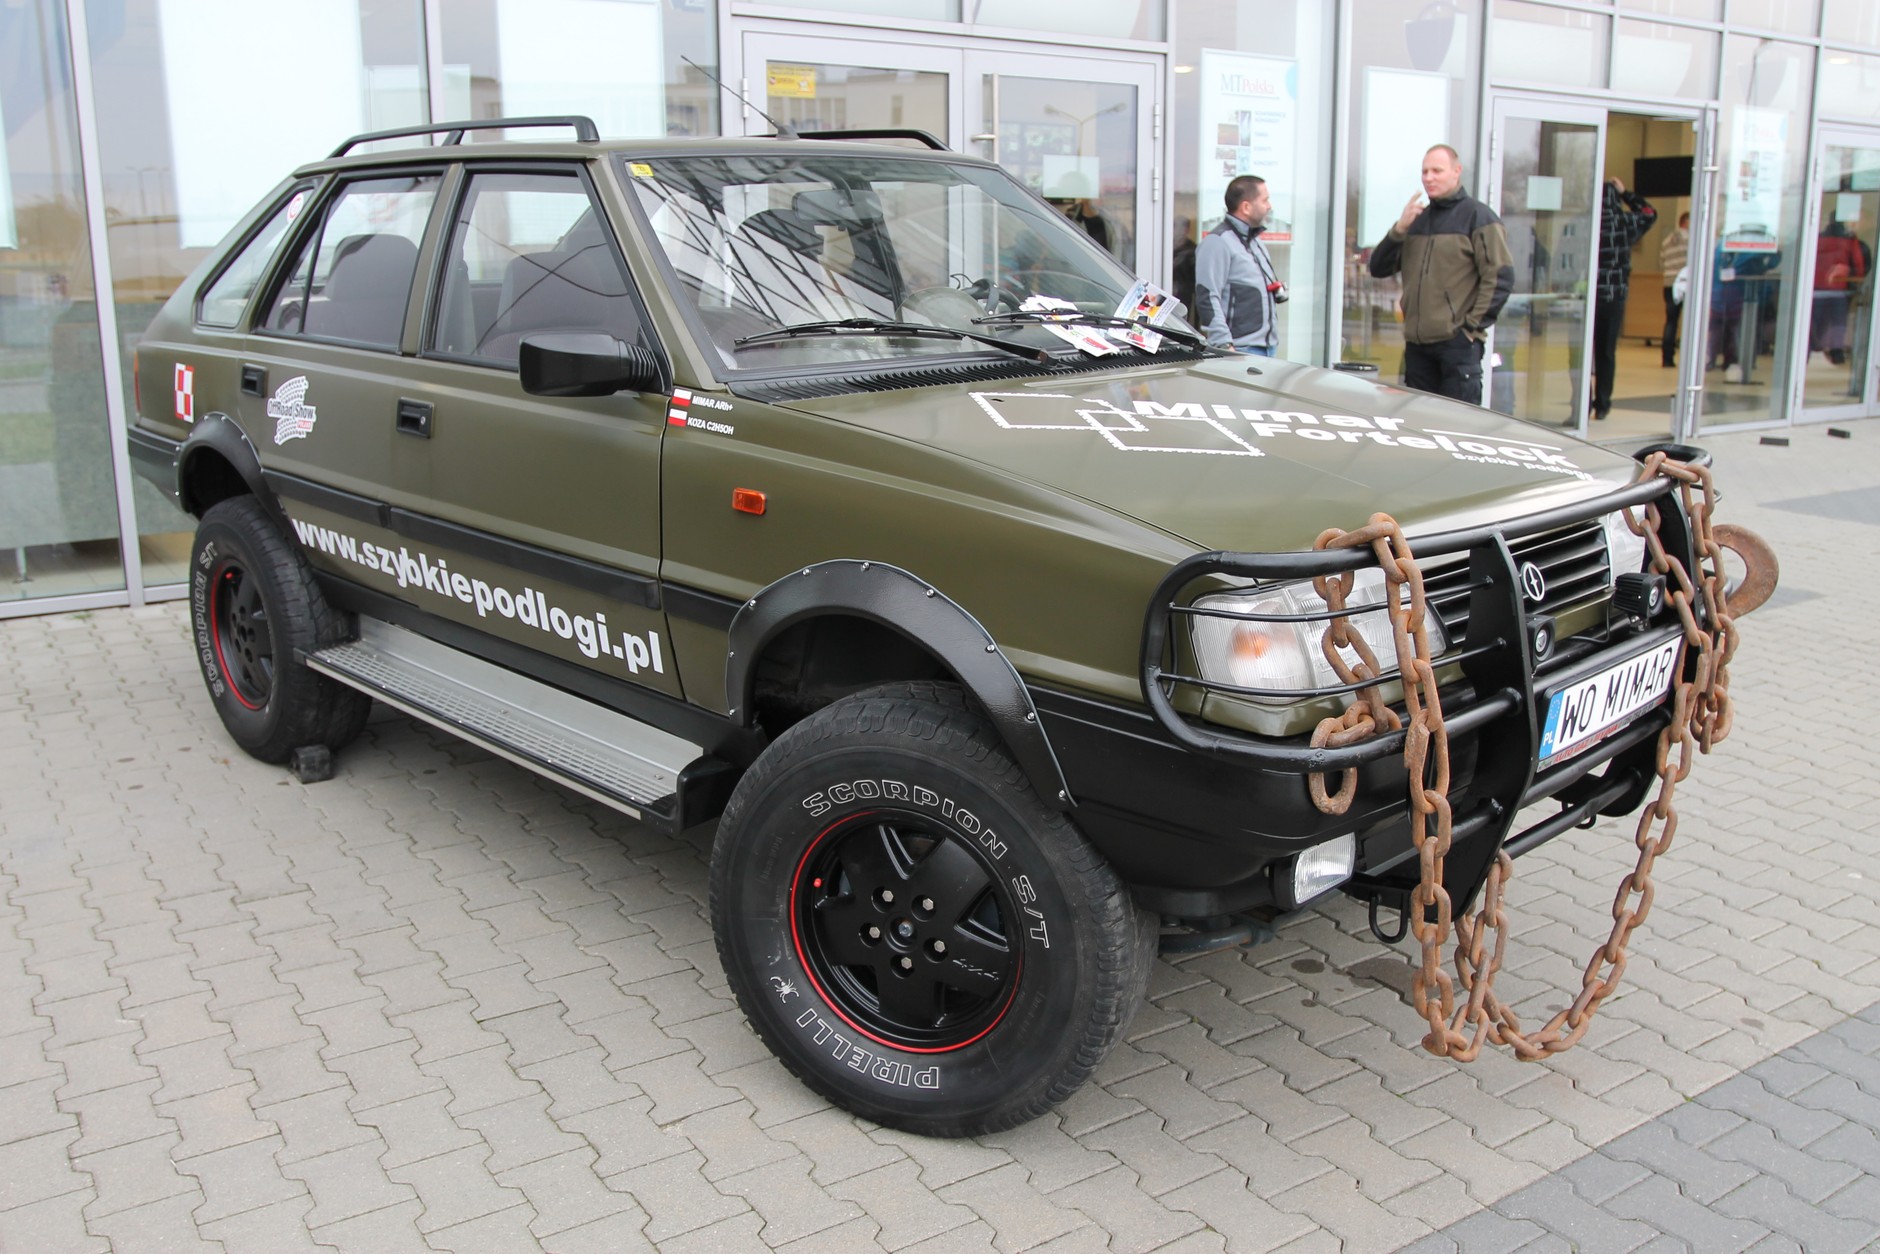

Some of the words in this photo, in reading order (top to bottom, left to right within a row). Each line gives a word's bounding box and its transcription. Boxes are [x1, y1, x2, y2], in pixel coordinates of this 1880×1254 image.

[294, 402, 314, 419] Show
[692, 395, 715, 408] MIMAR
[1132, 400, 1405, 431] Mimar
[687, 417, 706, 429] KOZA
[706, 421, 734, 435] C2H5OH
[1250, 422, 1580, 469] Fortelock
[291, 517, 665, 675] www.szybkiepodlogi.pl
[195, 571, 225, 698] SCORPION
[1600, 646, 1673, 722] MIMAR
[1542, 730, 1554, 747] PL
[802, 778, 1008, 861] SCORPION
[1011, 874, 1051, 950] S/T
[795, 1007, 940, 1090] PIRELLI
